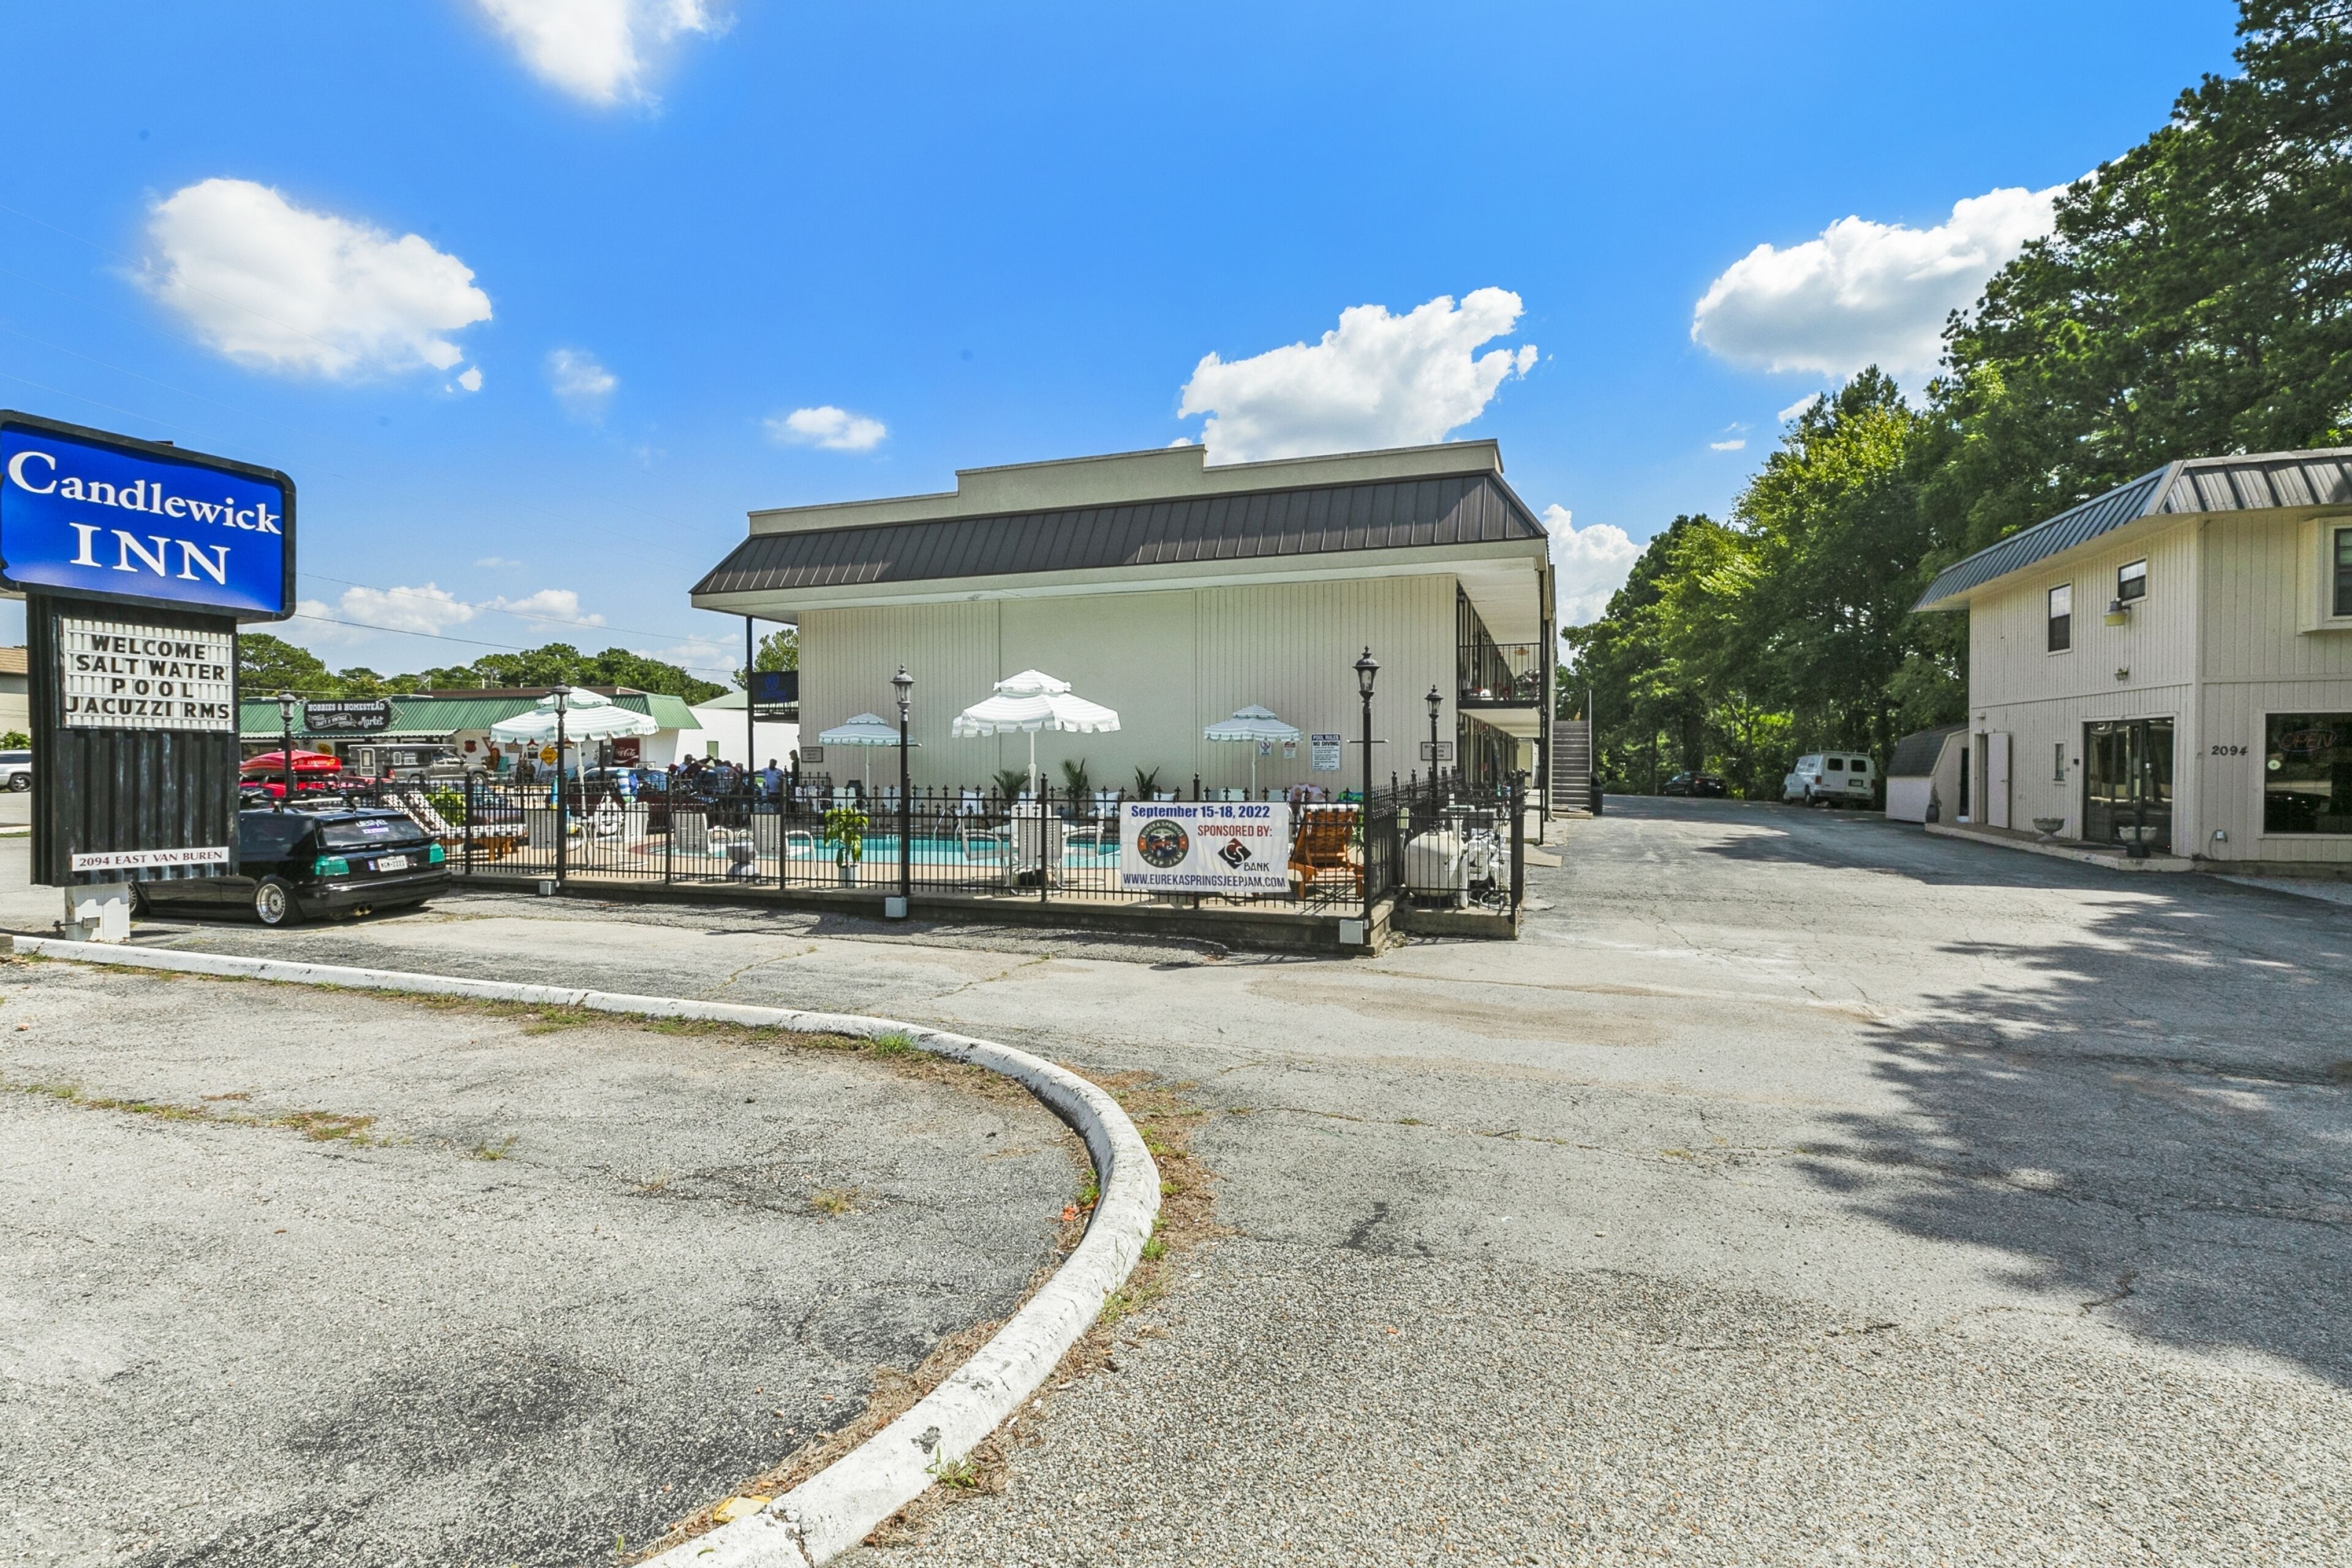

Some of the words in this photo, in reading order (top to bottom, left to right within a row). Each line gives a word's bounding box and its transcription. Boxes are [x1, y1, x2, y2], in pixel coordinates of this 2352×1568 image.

[8, 451, 281, 535] Candlewick
[69, 522, 230, 585] INN
[92, 635, 205, 660] WELCOME
[76, 655, 138, 674] SALT
[149, 660, 225, 680] WATER
[111, 678, 194, 698] POOL
[66, 696, 172, 717] JACUZZI
[184, 704, 230, 719] RMS
[358, 716, 384, 728] Market
[2280, 734, 2334, 748] OPEN
[2211, 745, 2248, 756] 2094
[1131, 805, 1197, 818] September
[1201, 806, 1235, 818] 15-18,
[1238, 806, 1270, 818] 2022
[1141, 822, 1161, 838] EUREKA
[1161, 822, 1184, 837] SPRINGS
[1197, 825, 1254, 836] SPONSORED
[1256, 826, 1273, 837] BY:
[79, 858, 110, 867] 2094
[115, 854, 148, 865] EAST
[153, 853, 178, 862] VAN
[183, 851, 222, 861] BUREN
[1143, 853, 1164, 865] JEEP
[1169, 851, 1183, 865] JAM
[1244, 862, 1270, 872] BANK
[1123, 873, 1286, 888] WWW.EUREKASPRINGSJEEPJAM.COM
